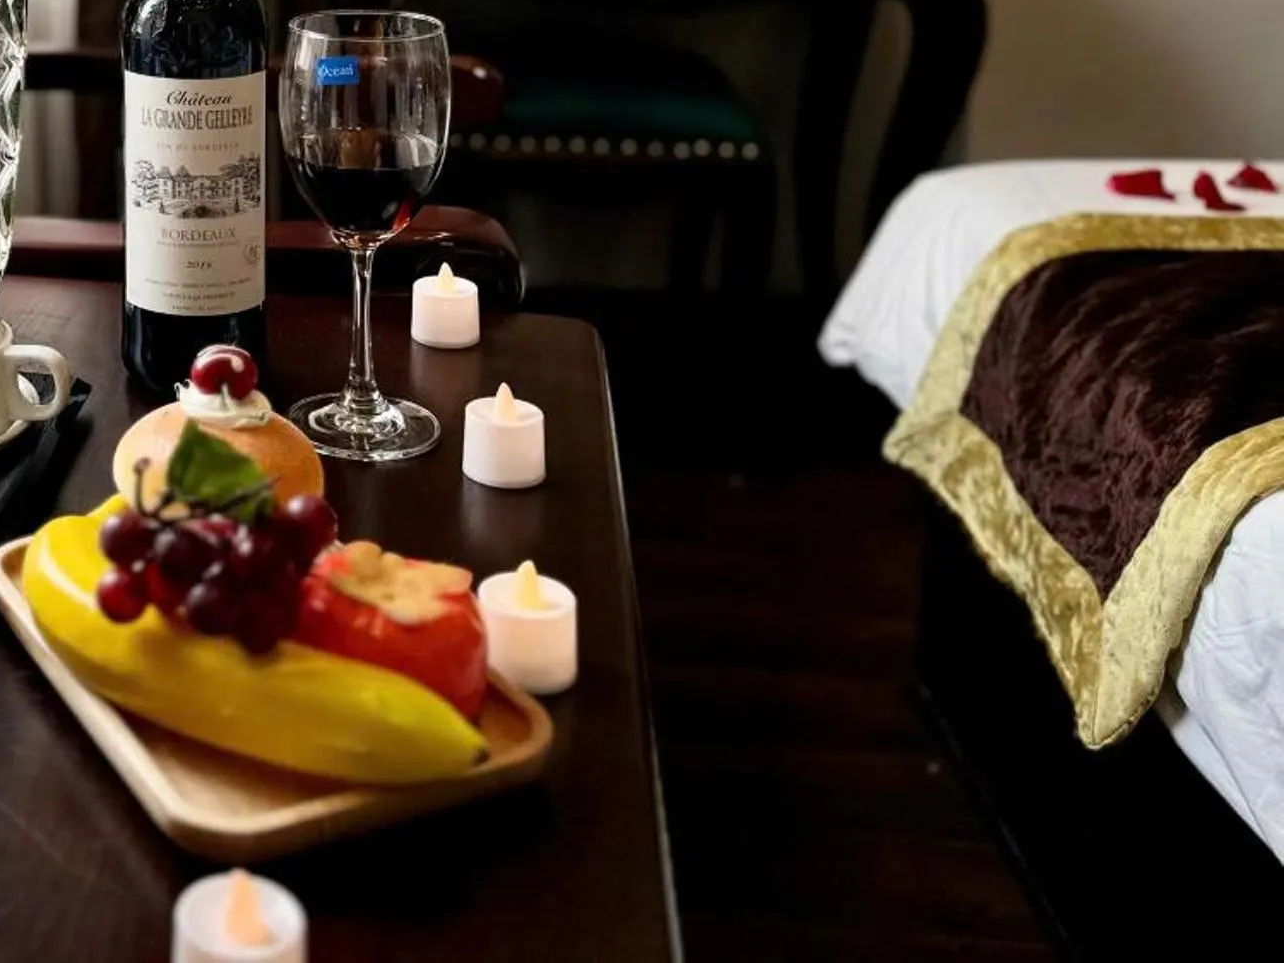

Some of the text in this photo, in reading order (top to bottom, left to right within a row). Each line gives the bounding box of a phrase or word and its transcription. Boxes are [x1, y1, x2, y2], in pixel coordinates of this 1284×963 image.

[166, 90, 233, 107] Château
[141, 105, 153, 127] LA
[154, 107, 203, 130] GRANDE
[161, 227, 236, 242] BORDEAUX
